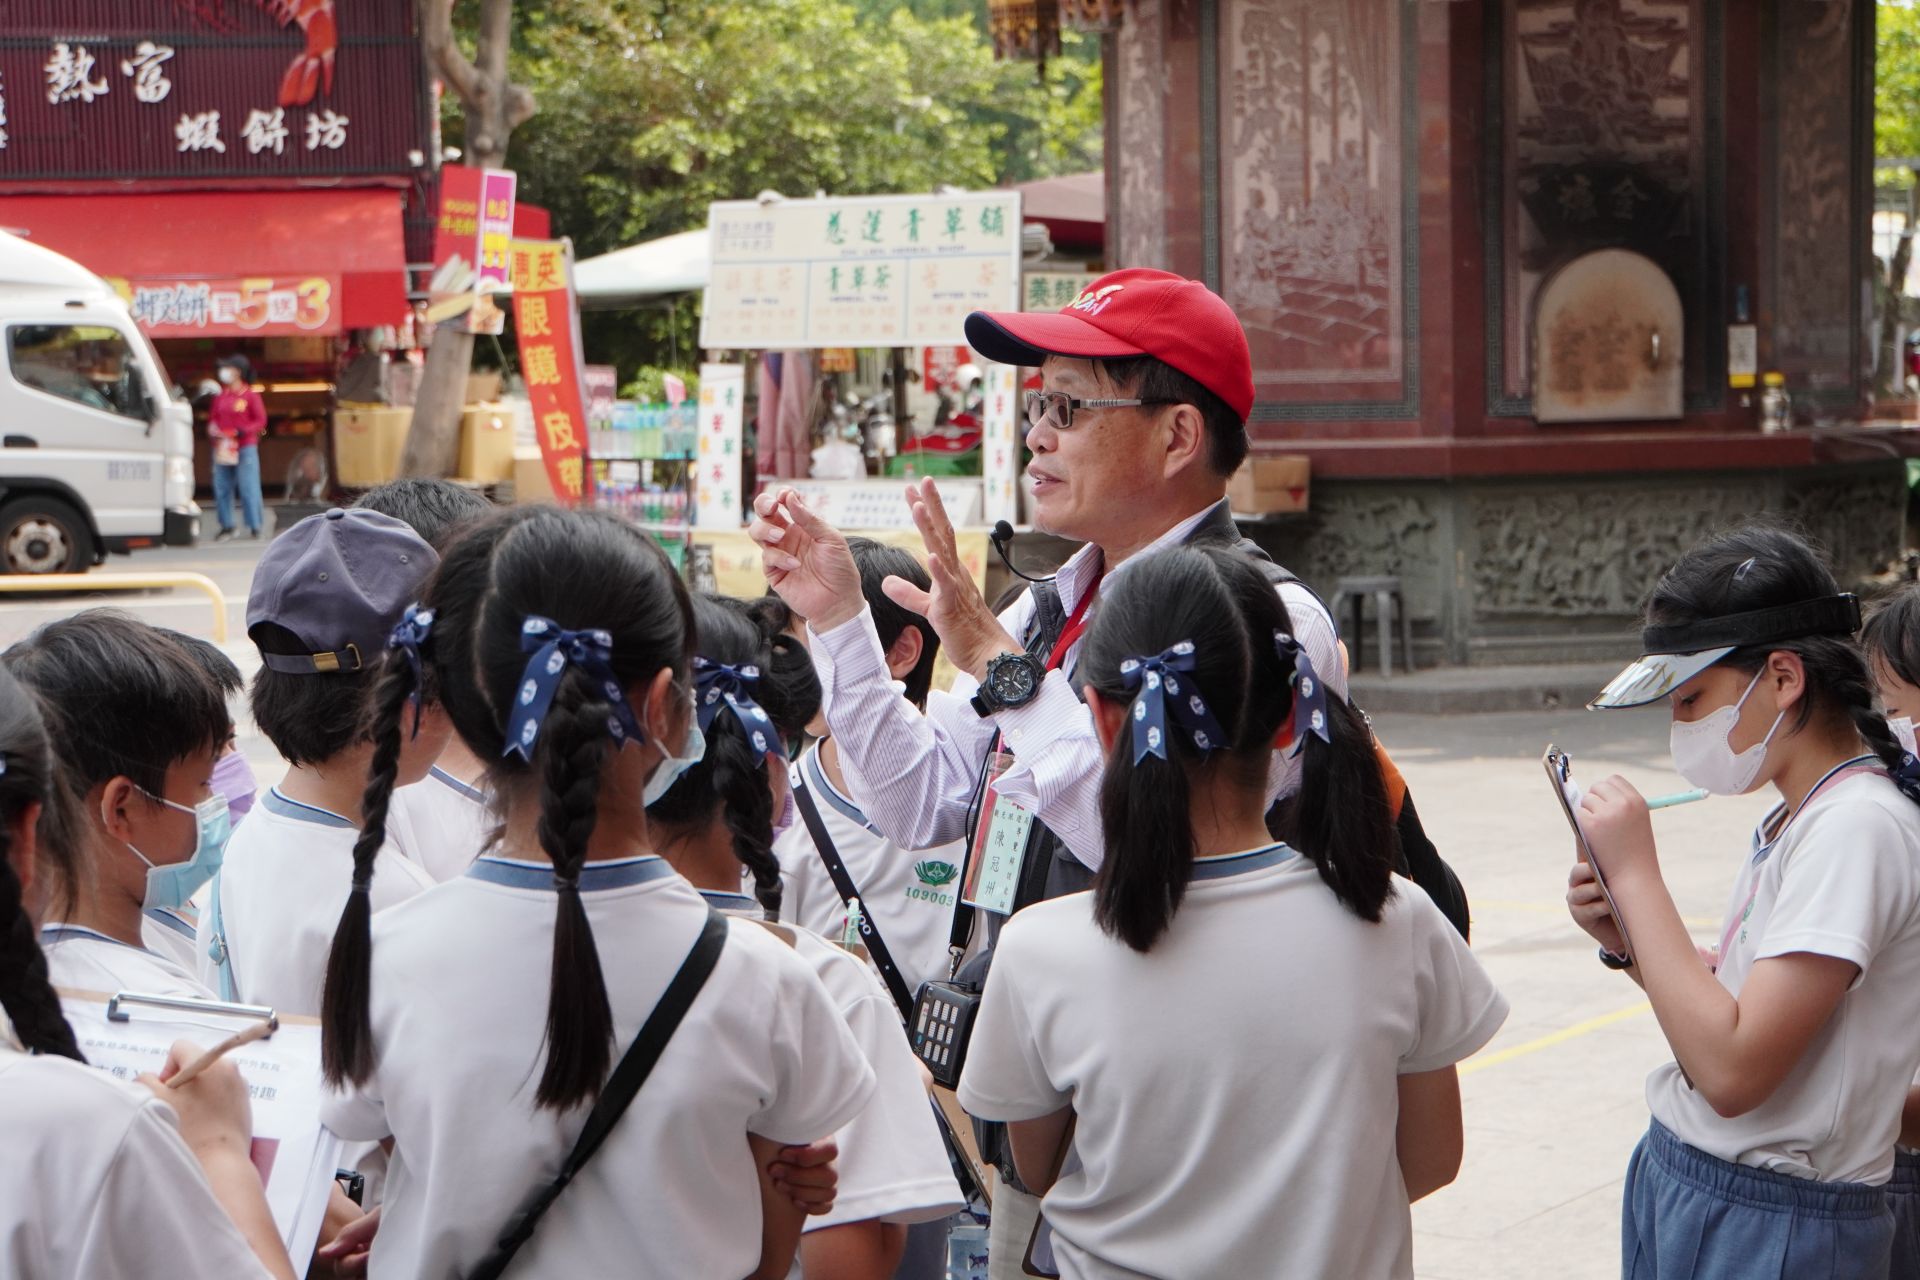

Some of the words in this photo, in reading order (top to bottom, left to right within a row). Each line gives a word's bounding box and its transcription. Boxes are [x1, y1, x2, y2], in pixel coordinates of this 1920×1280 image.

[175, 108, 349, 154] 蝦餅坊
[905, 886, 954, 907] 109003
